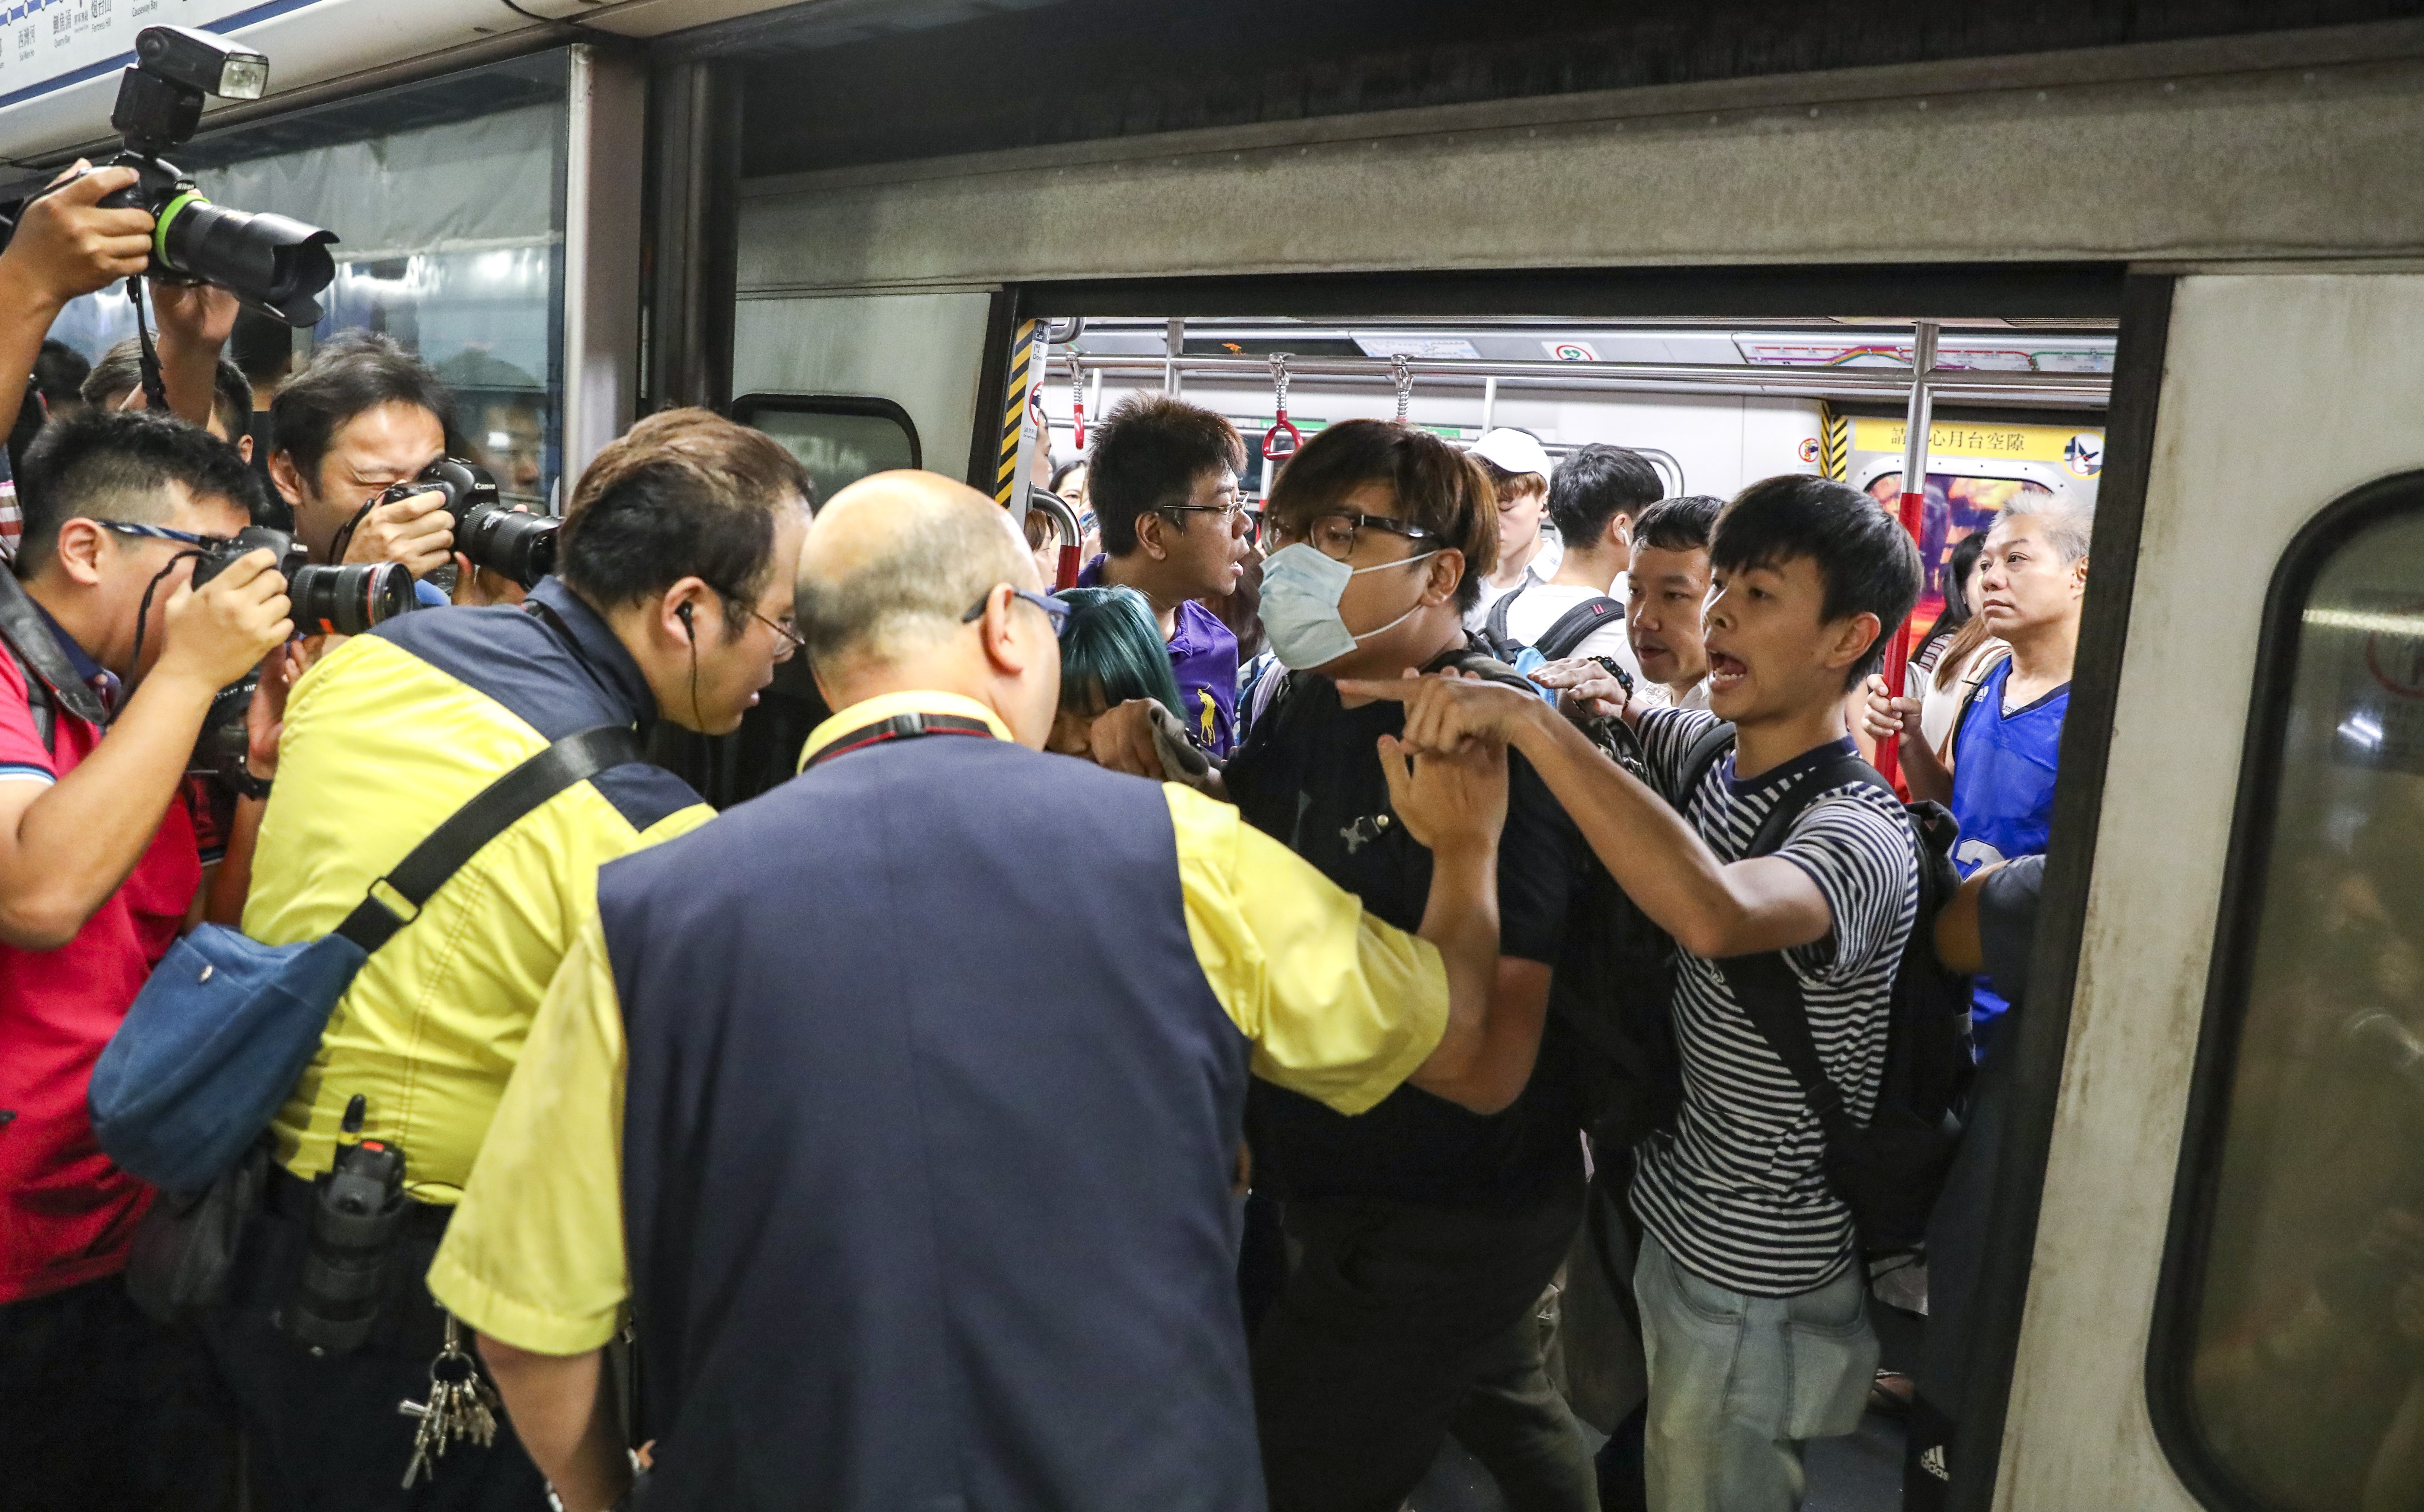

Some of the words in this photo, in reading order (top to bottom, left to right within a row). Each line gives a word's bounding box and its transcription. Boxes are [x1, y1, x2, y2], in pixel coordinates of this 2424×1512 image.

[132, 4, 150, 17] Causeway
[1034, 343, 1040, 353] 門
[1891, 427, 2025, 451] 請心月台空隙
